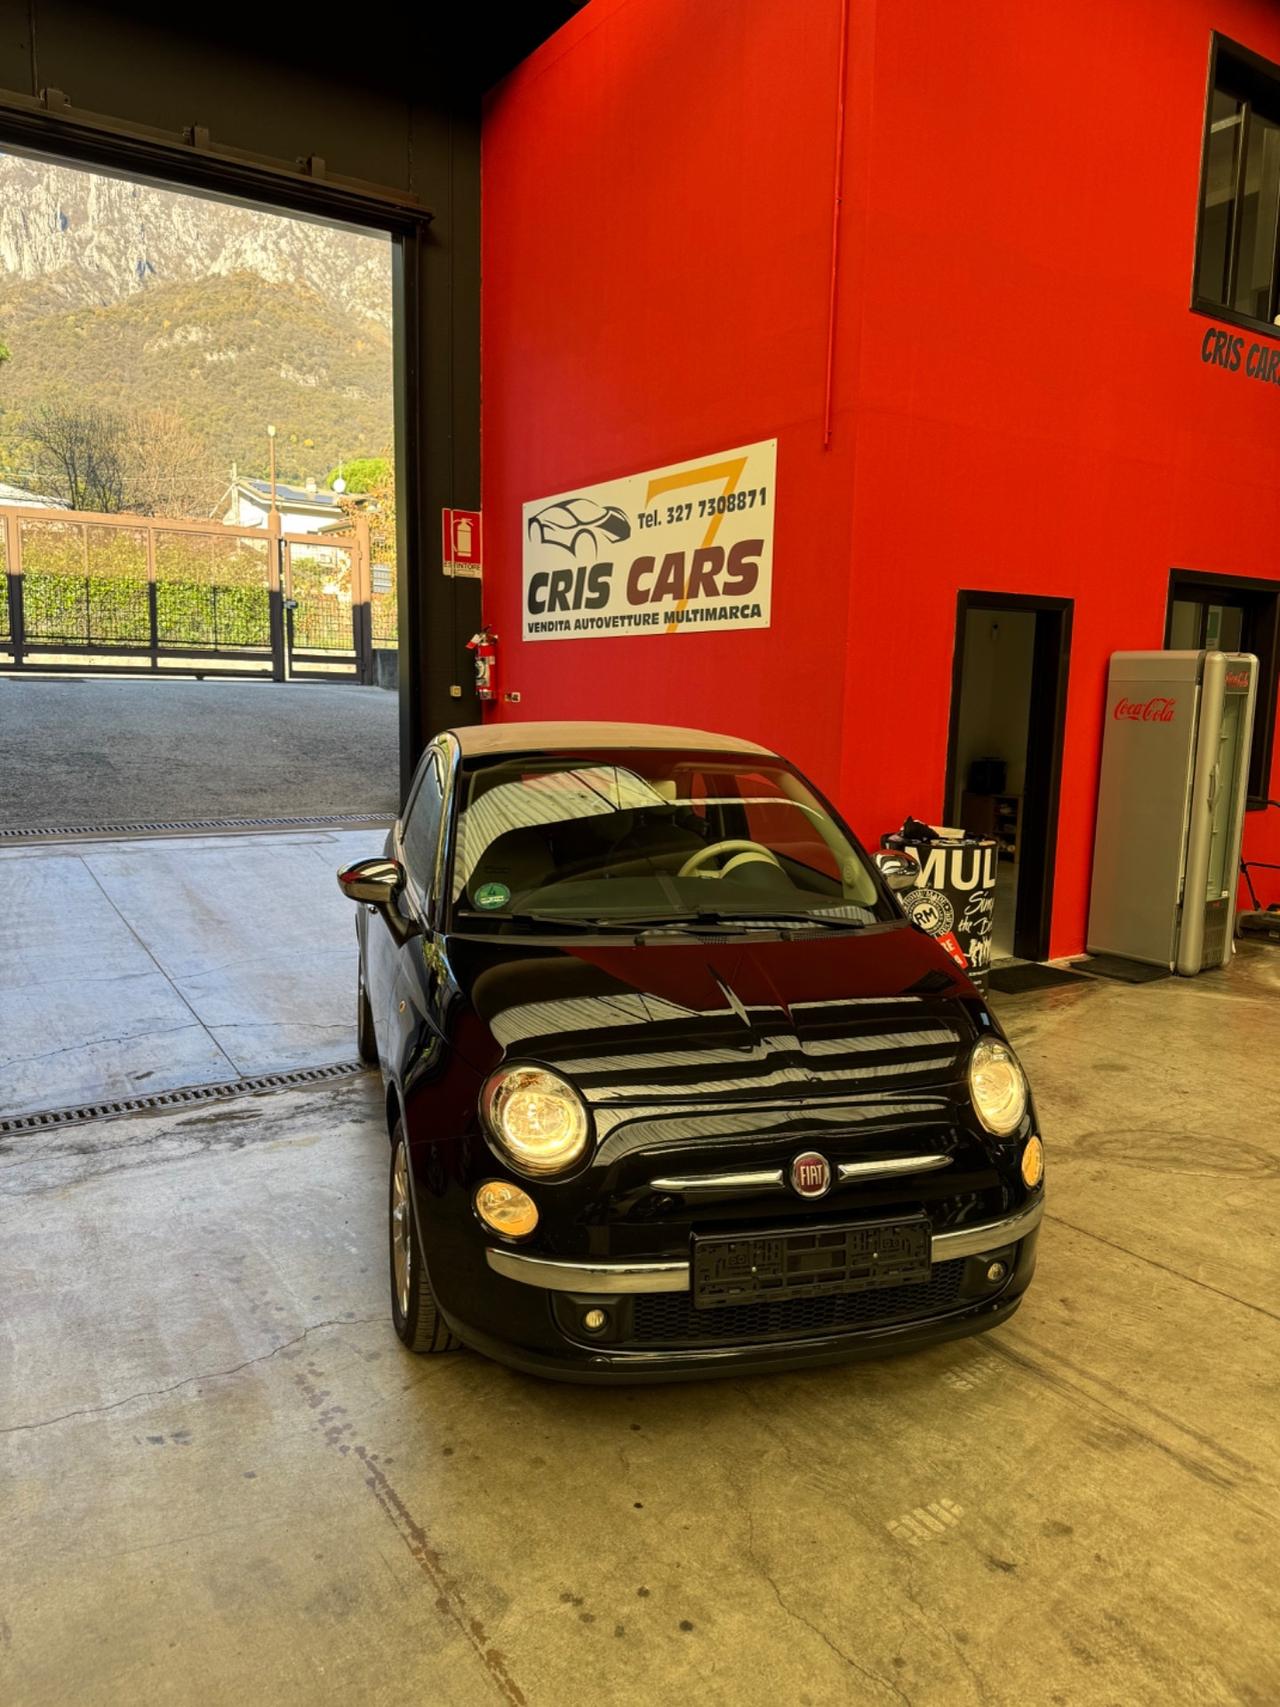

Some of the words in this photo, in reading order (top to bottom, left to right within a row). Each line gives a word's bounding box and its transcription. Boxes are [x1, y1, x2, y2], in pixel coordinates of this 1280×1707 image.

[1202, 327, 1245, 371] CRIS
[1246, 344, 1280, 385] CAR
[638, 510, 662, 529] Tel.
[667, 503, 693, 524] 327
[698, 487, 767, 517] 7308871
[527, 562, 614, 615] CRIS
[626, 539, 765, 606] CARS
[528, 620, 571, 634] VENDITA
[574, 612, 660, 631] AUTOVETTURE
[664, 604, 762, 625] MULTIMARCA
[1113, 697, 1176, 722] Coca-Cola
[914, 907, 938, 926] RM
[800, 1165, 823, 1185] FIAT
